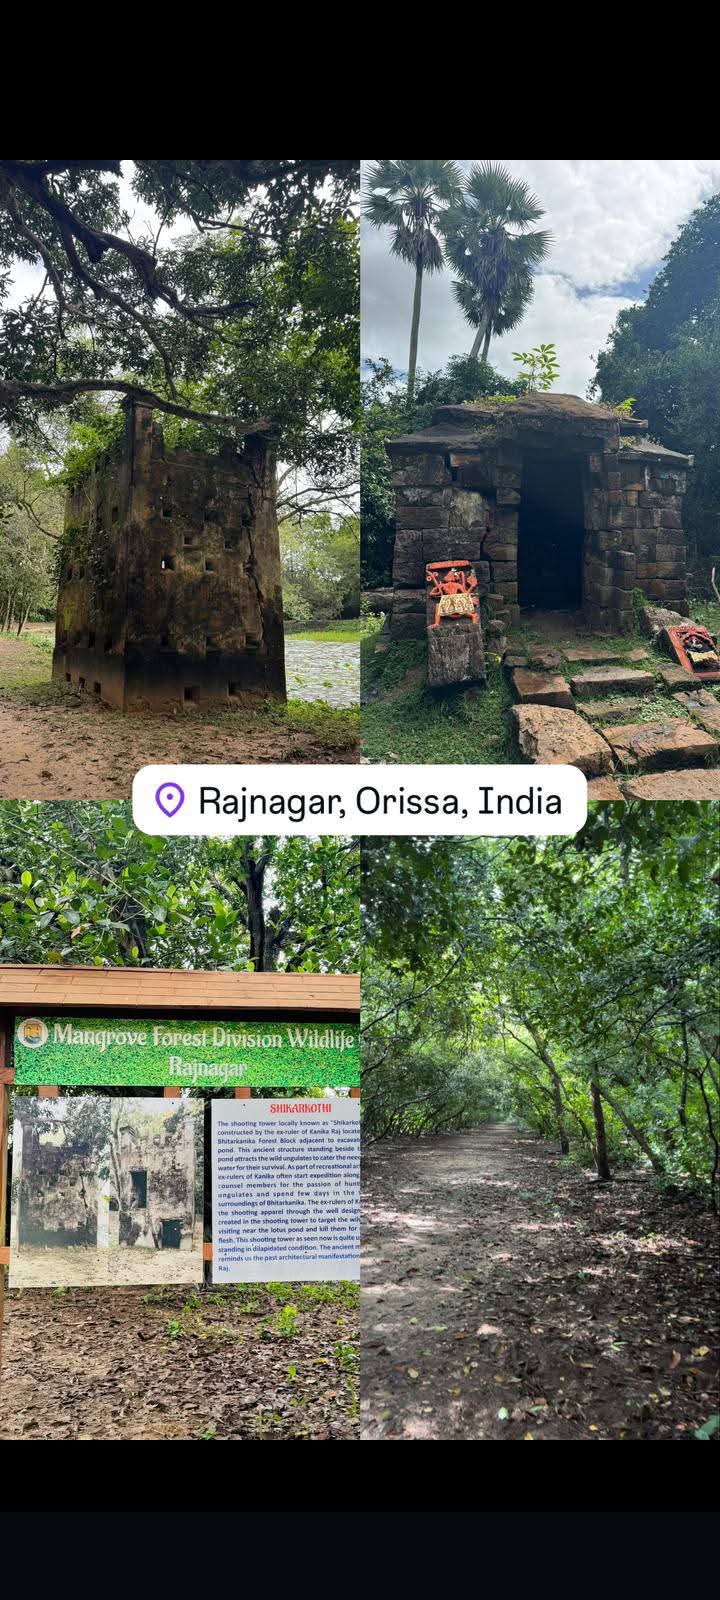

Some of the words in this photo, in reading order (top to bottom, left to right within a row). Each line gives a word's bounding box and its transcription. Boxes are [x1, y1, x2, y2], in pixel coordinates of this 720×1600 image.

[53, 1023, 147, 1052] Mangrove
[152, 1025, 208, 1046] Forest
[212, 1027, 282, 1048] Division
[287, 1029, 355, 1052] Wildlife
[169, 1056, 248, 1083] Rajnagar
[270, 1104, 331, 1113] SHIKARKOTHI
